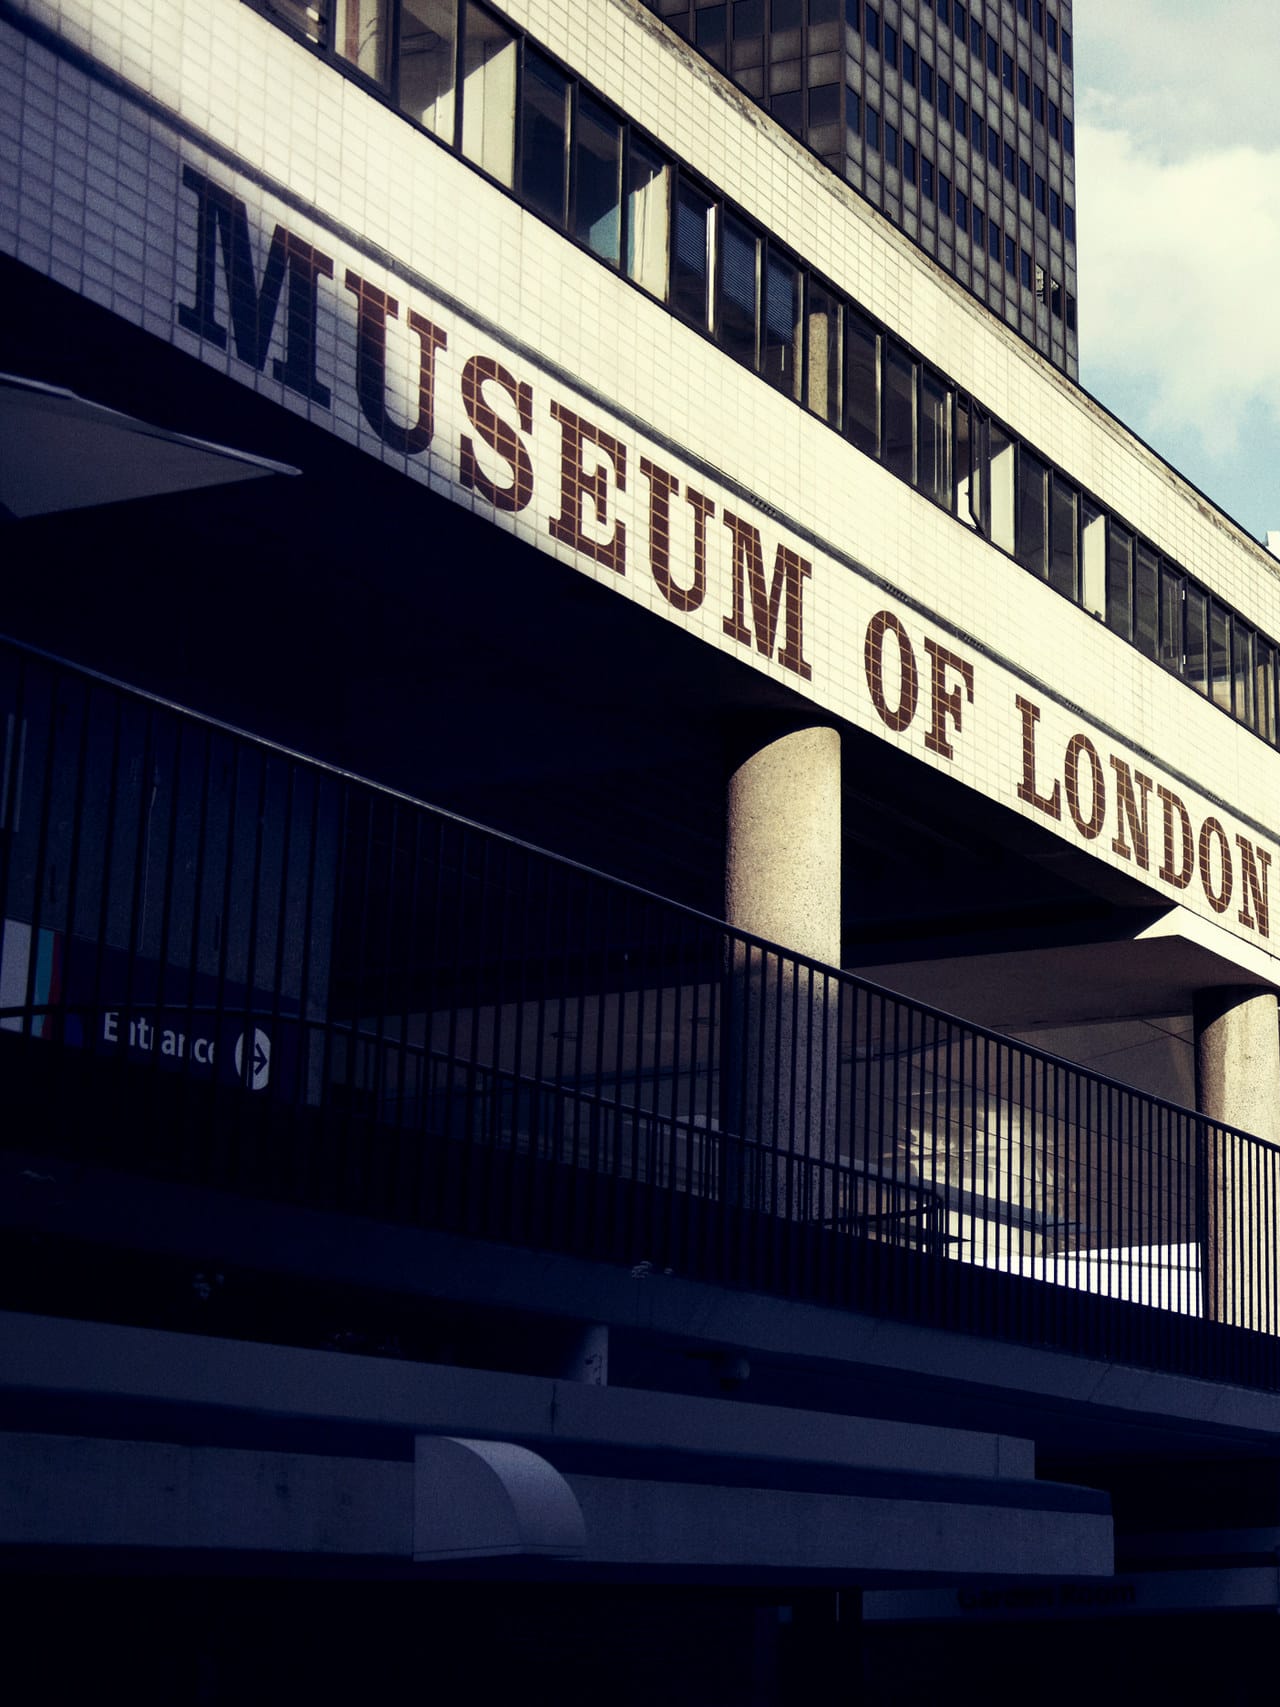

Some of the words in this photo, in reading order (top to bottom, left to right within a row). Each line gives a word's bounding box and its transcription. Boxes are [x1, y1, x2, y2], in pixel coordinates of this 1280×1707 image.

[177, 164, 812, 681] MUSEUM
[863, 609, 974, 760] OF
[1014, 693, 1272, 938] LONDON
[103, 1011, 215, 1064] Etanc
